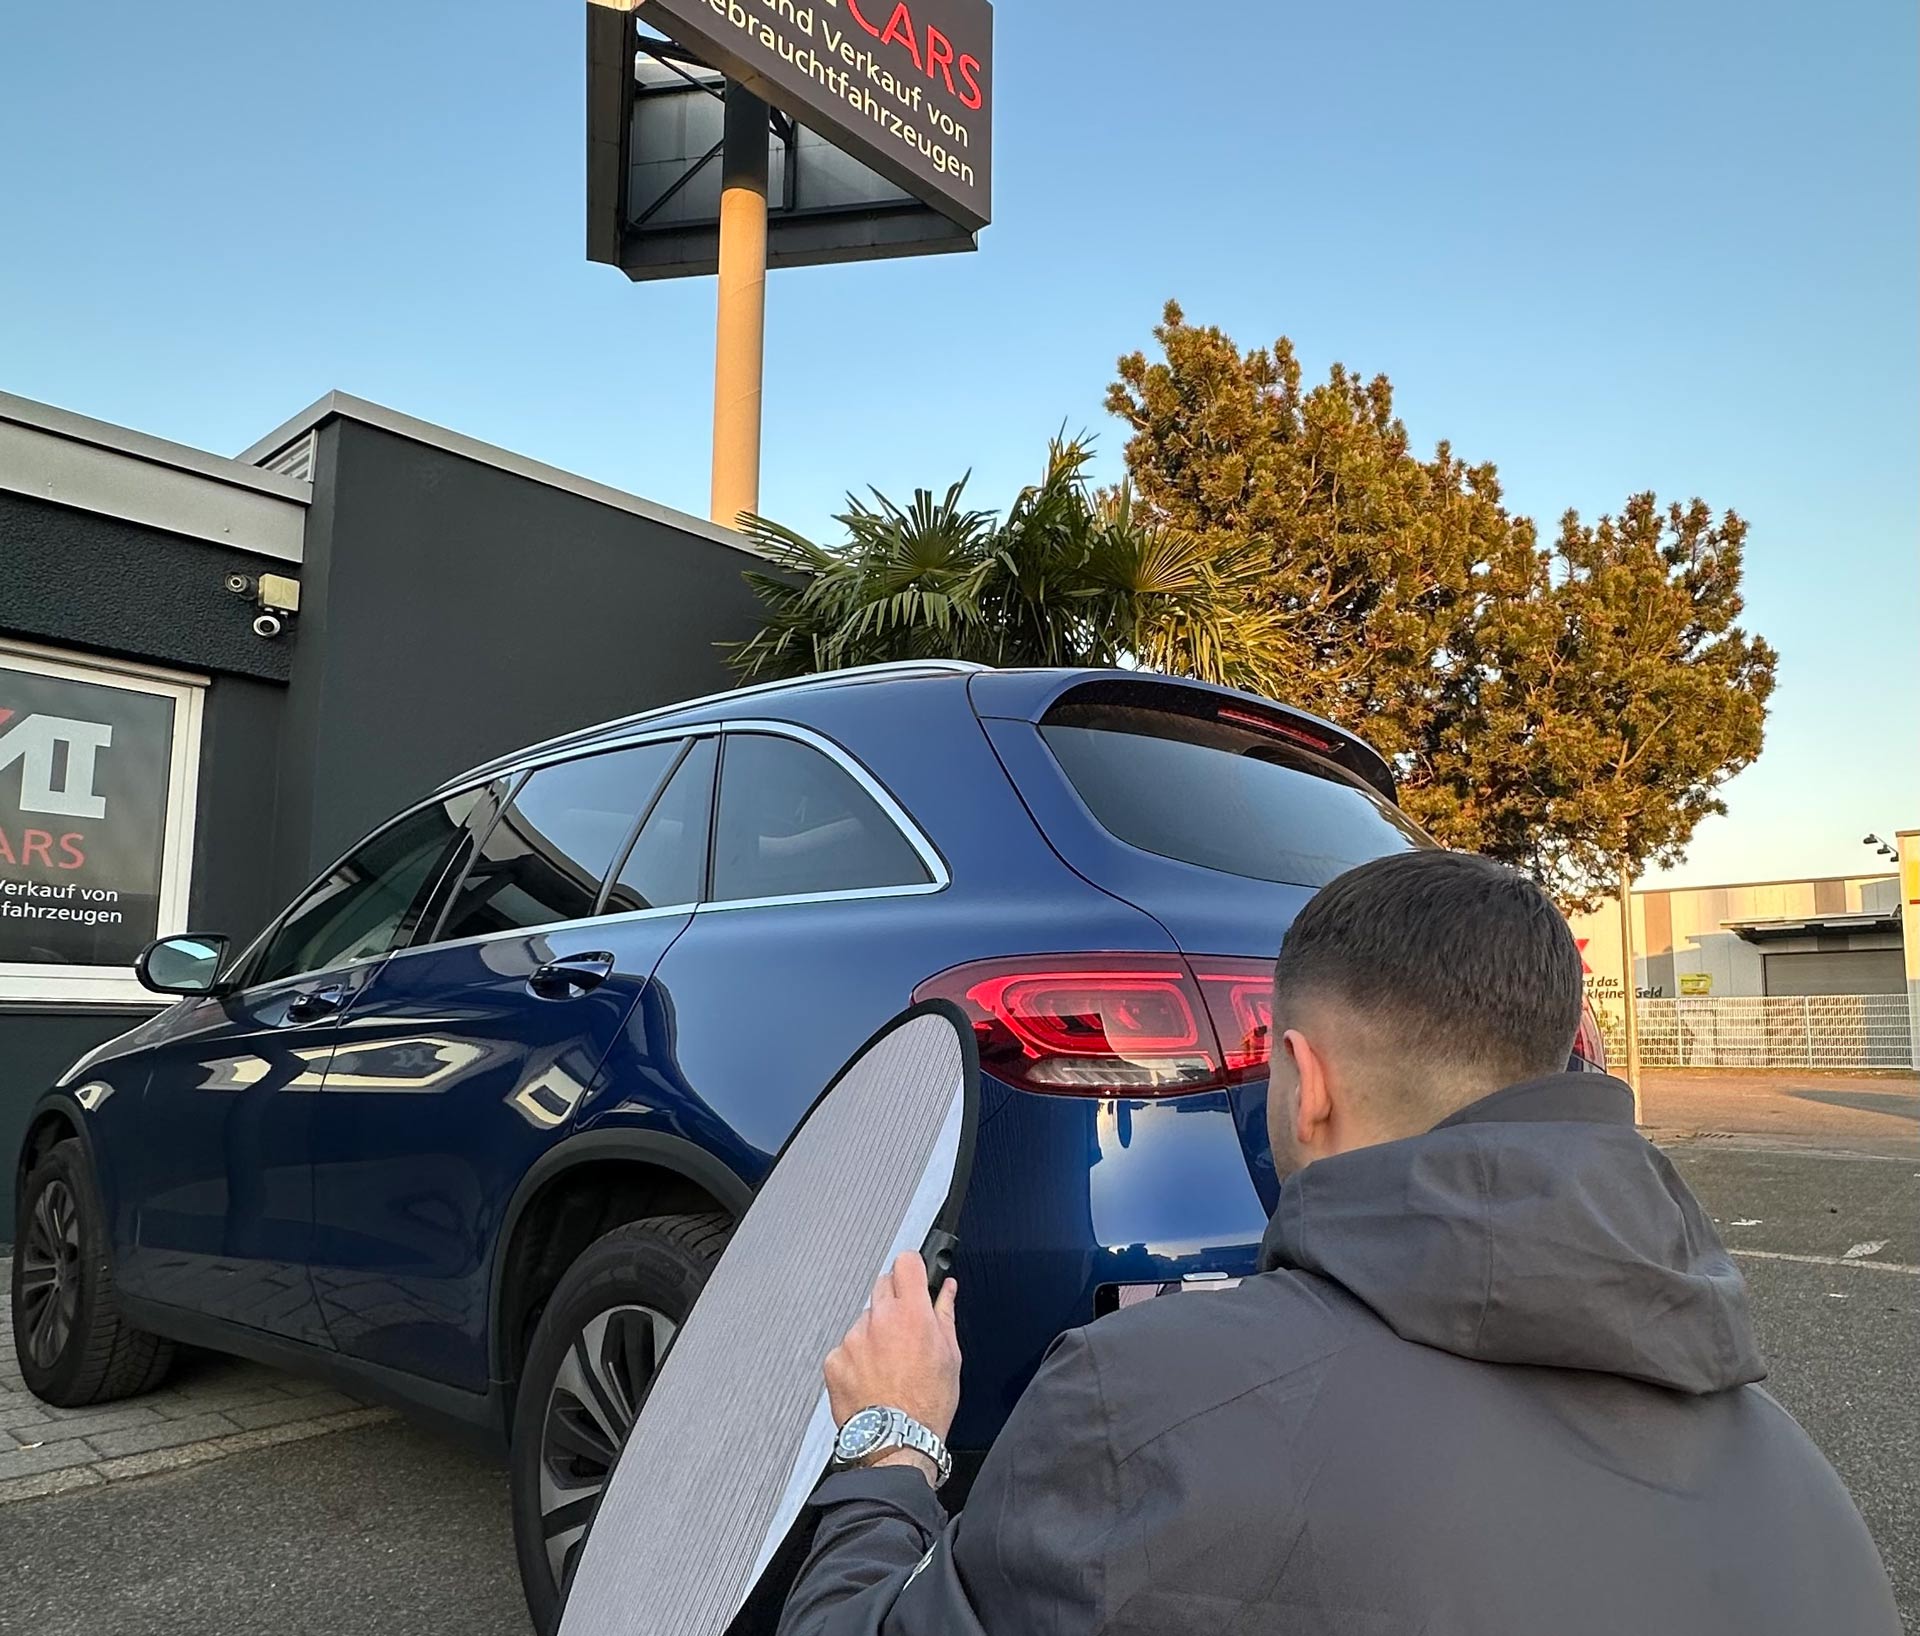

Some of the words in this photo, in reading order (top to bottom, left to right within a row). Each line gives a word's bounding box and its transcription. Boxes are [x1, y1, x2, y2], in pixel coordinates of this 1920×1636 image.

[821, 19, 922, 113] Verkauf
[927, 102, 969, 148] von
[702, 0, 975, 188] ebrauchtfahrzeugen
[80, 888, 118, 902] von
[1597, 976, 1619, 988] das
[1635, 986, 1663, 999] Geld
